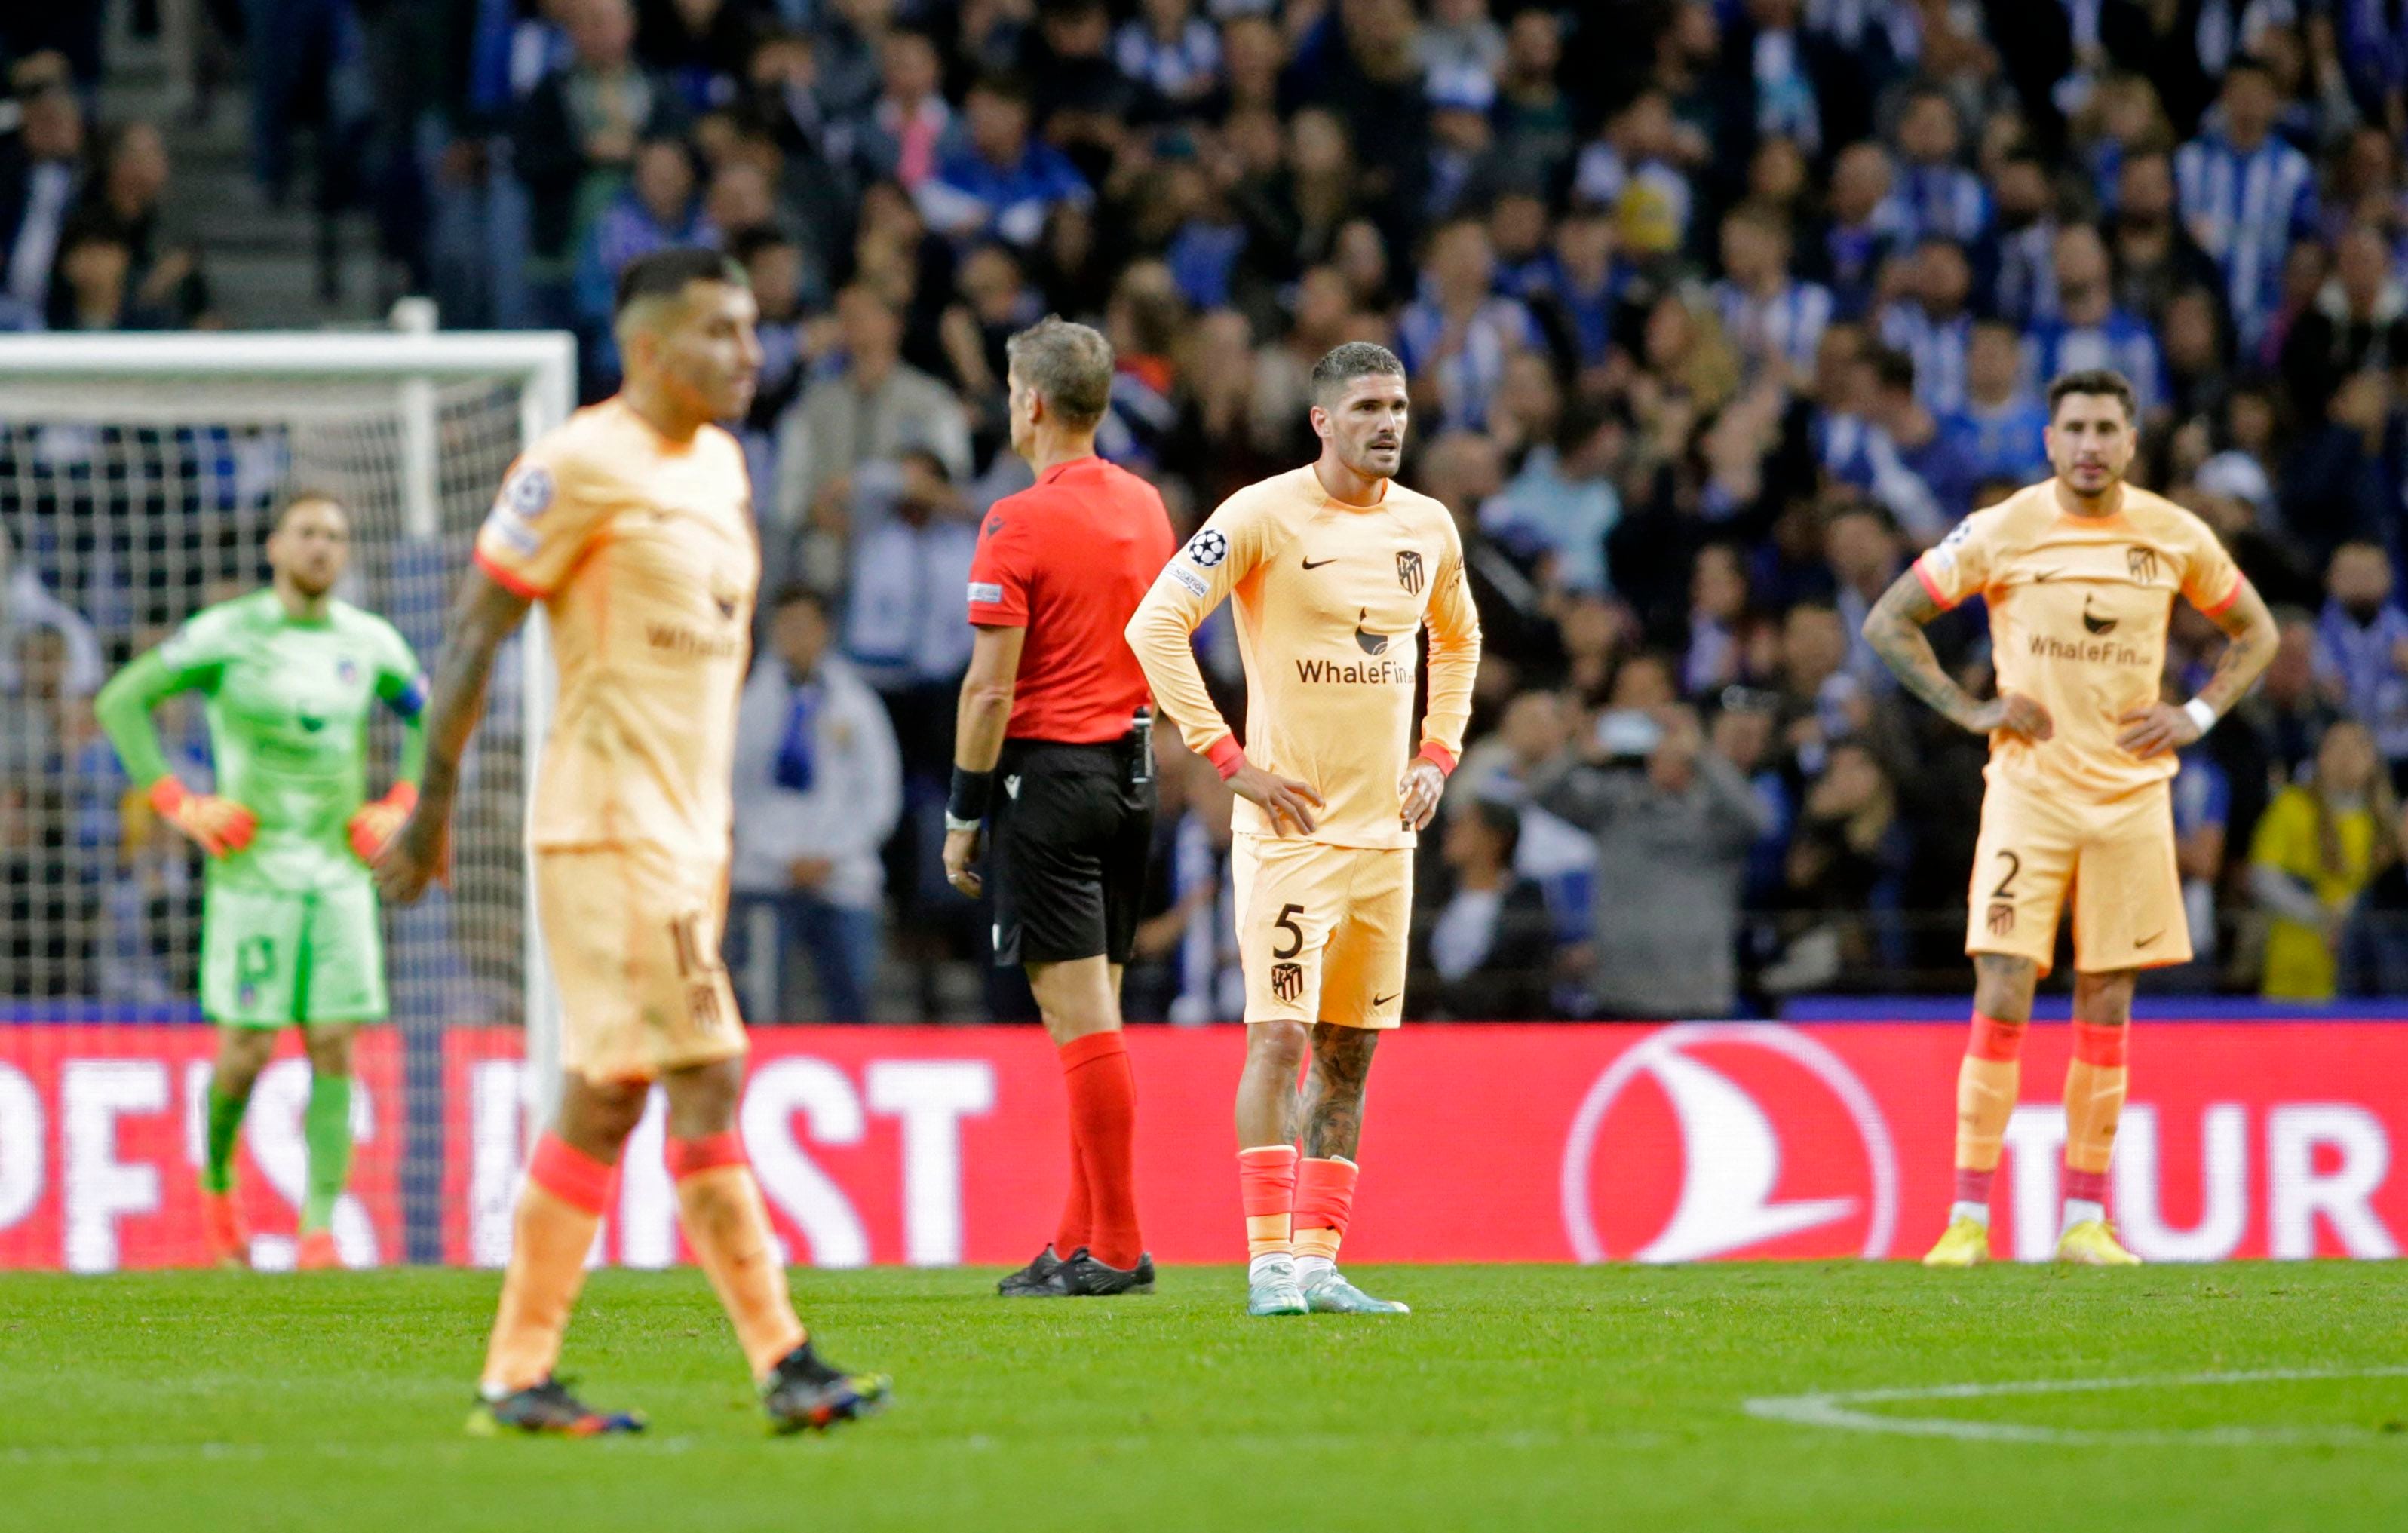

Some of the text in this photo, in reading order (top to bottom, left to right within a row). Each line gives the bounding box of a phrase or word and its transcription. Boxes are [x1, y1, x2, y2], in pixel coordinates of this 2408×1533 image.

[1989, 850, 2020, 898] 2
[1272, 903, 1305, 960] 5
[2002, 1102, 2406, 1262] TUR
